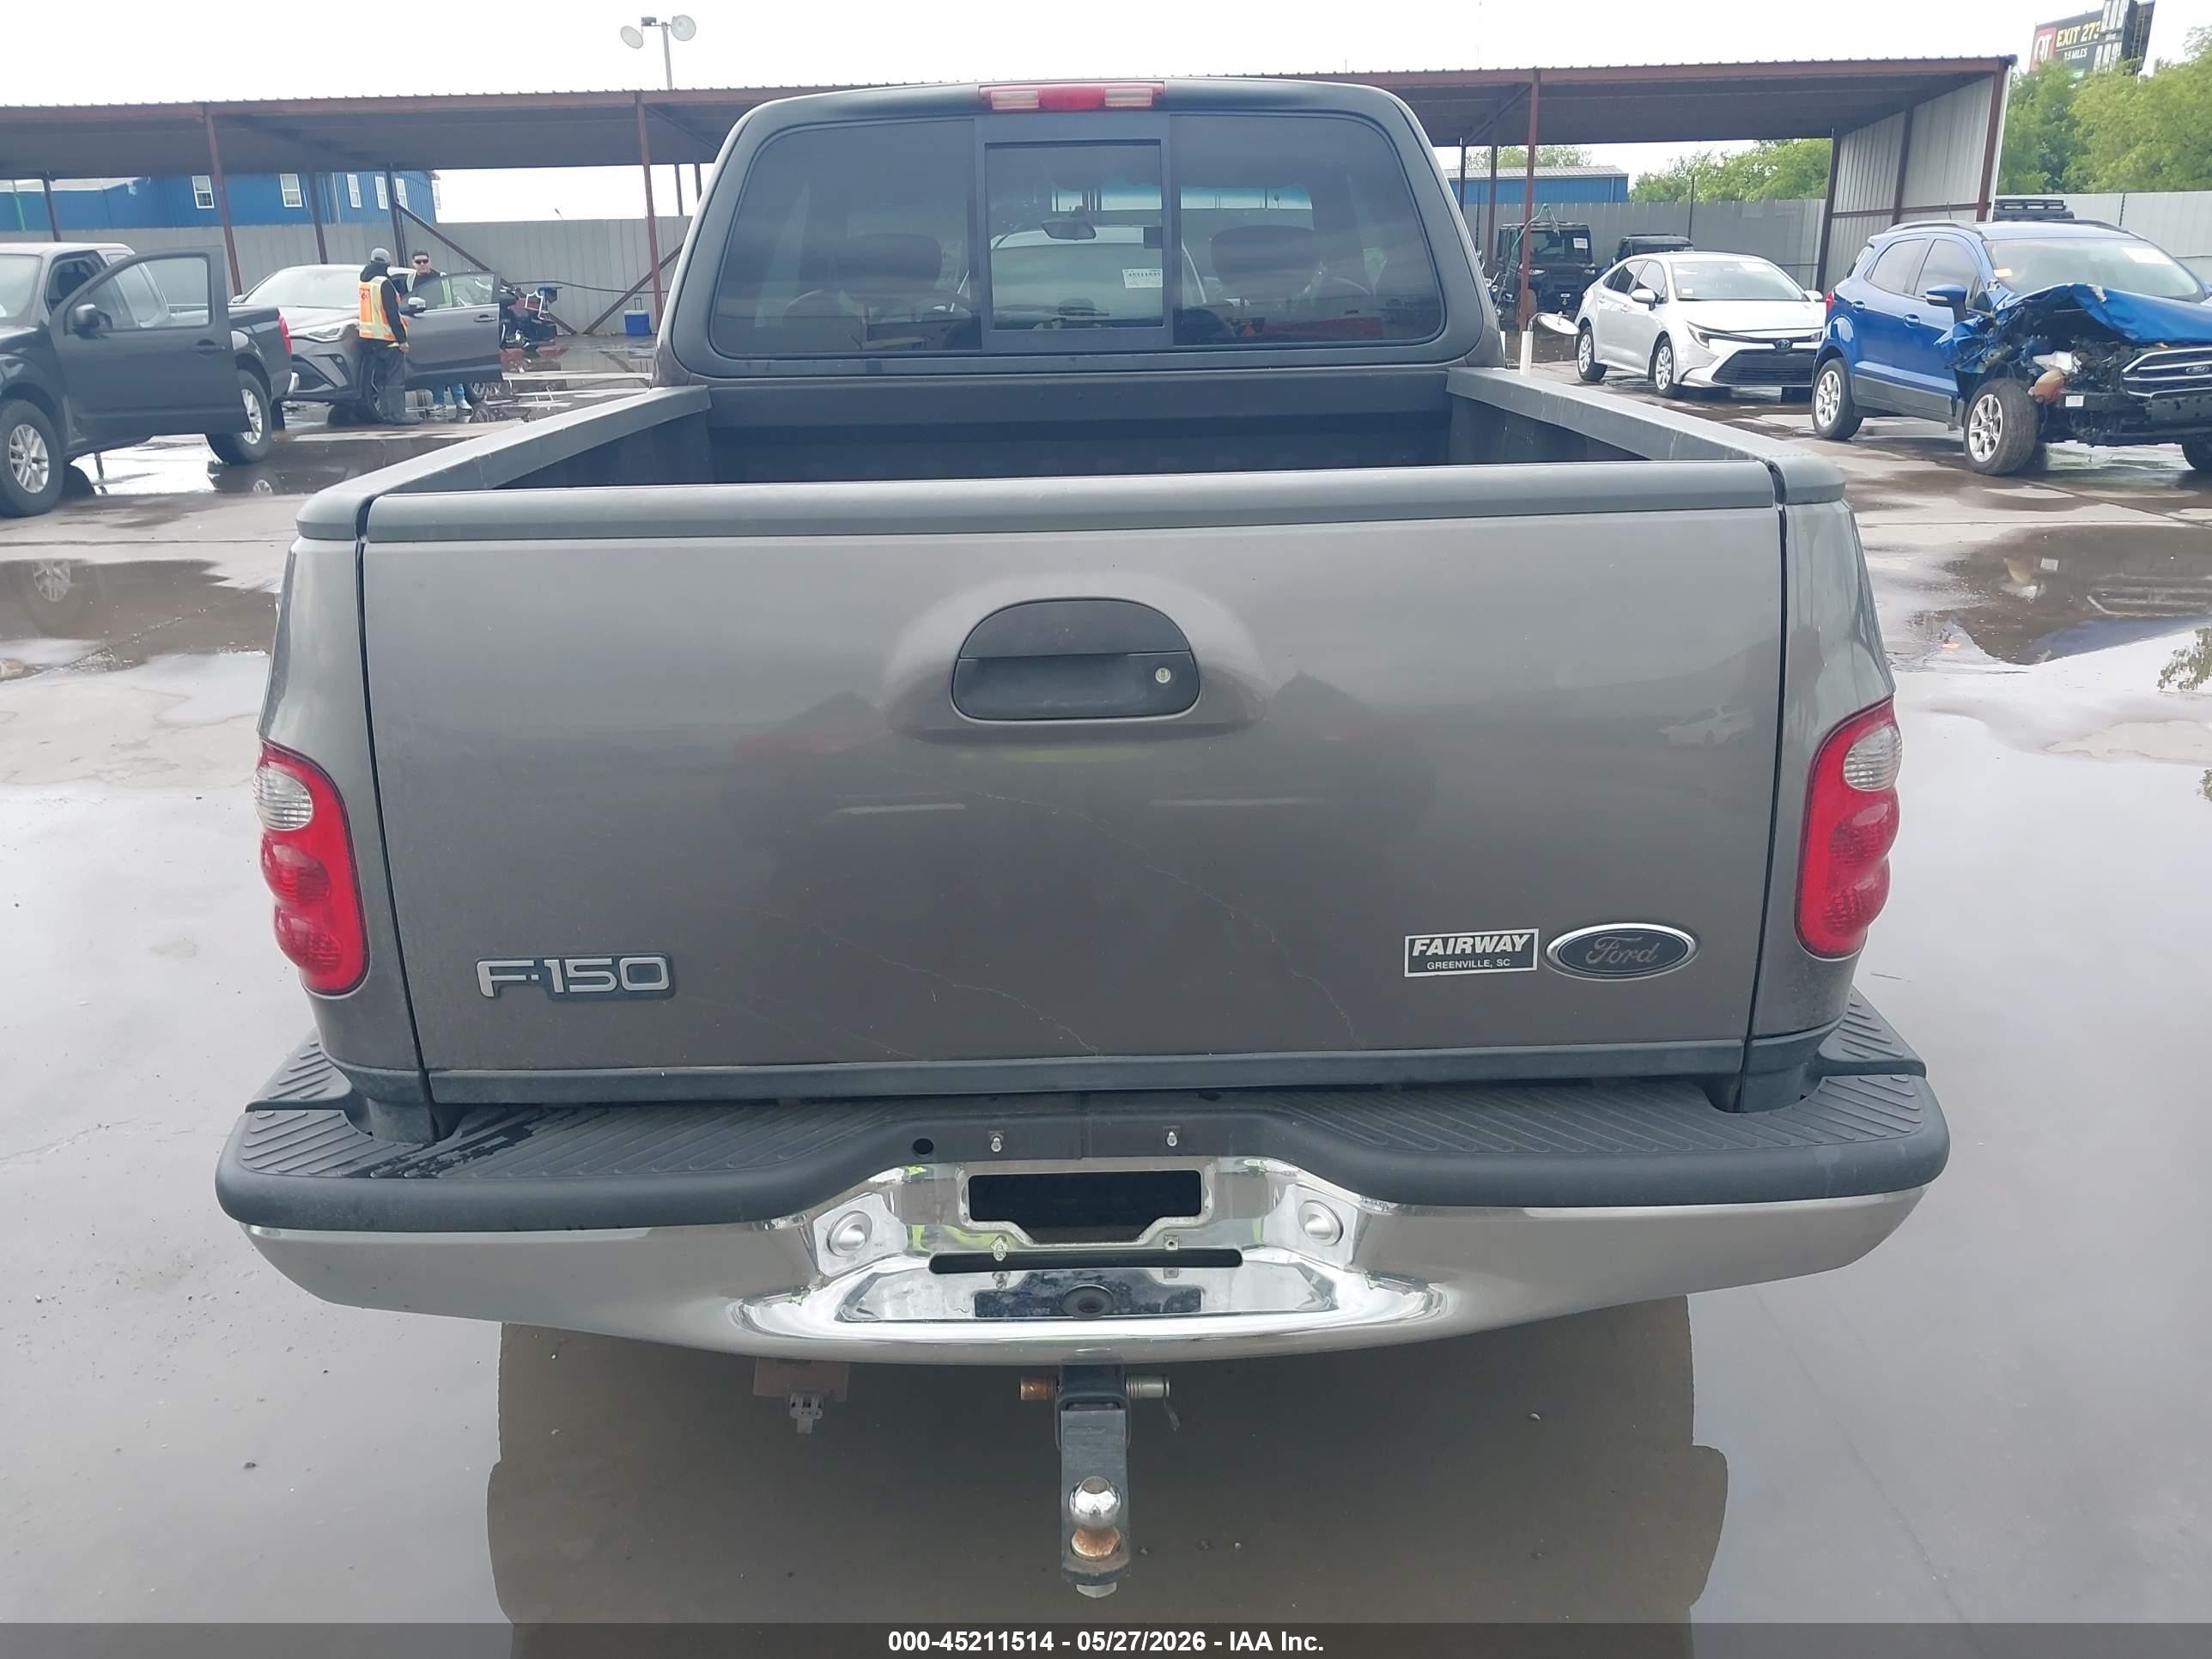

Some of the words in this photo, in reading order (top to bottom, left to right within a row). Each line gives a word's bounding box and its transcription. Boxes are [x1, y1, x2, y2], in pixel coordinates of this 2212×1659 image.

[2057, 27, 2080, 47] EXIT
[2072, 48, 2087, 59] MILES
[1412, 933, 1532, 957] FAIRWAY
[1585, 937, 1658, 963] Ford
[1426, 959, 1493, 970] GREENVILLE,
[1496, 957, 1511, 968] SC
